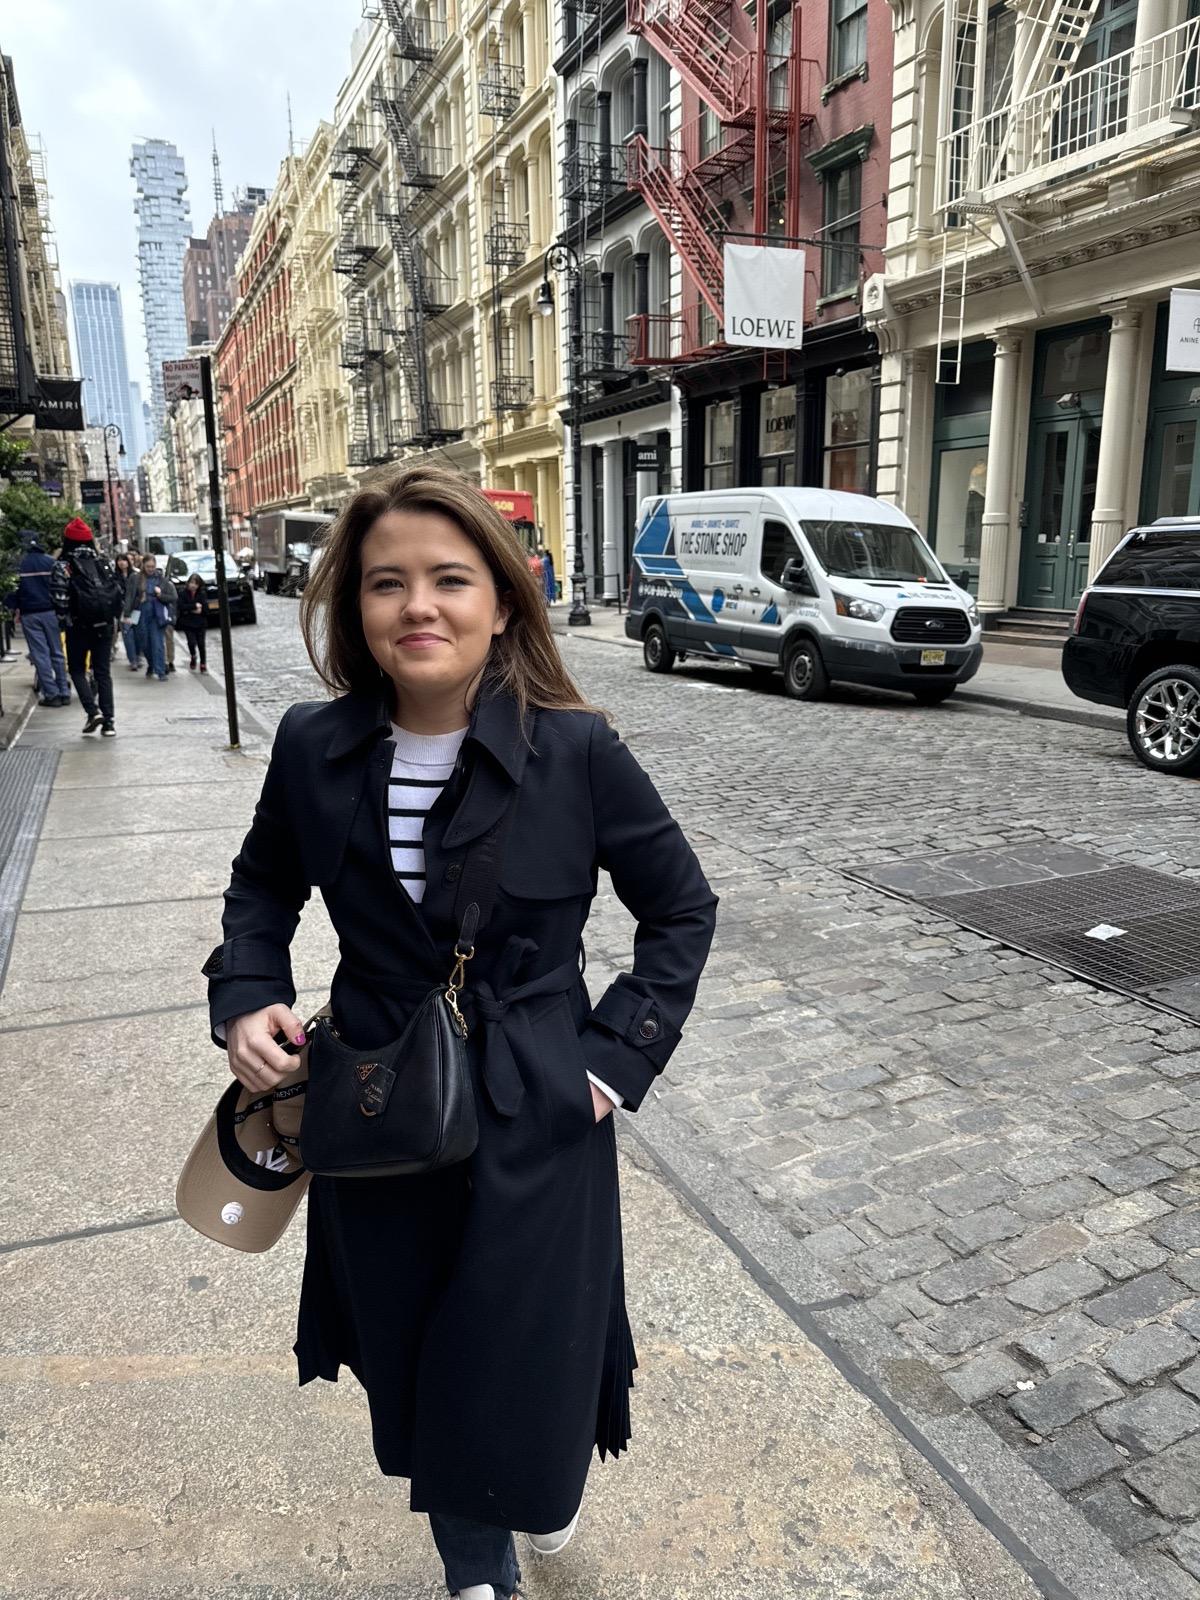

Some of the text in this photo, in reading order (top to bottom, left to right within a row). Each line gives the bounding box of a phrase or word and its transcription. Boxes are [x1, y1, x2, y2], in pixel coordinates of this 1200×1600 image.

[731, 316, 796, 339] LOEWE
[174, 362, 199, 371] PARKING
[38, 400, 79, 410] AMIRI
[766, 414, 796, 433] LOEW
[637, 449, 657, 460] ami
[680, 532, 748, 557] THE STONE SHOP
